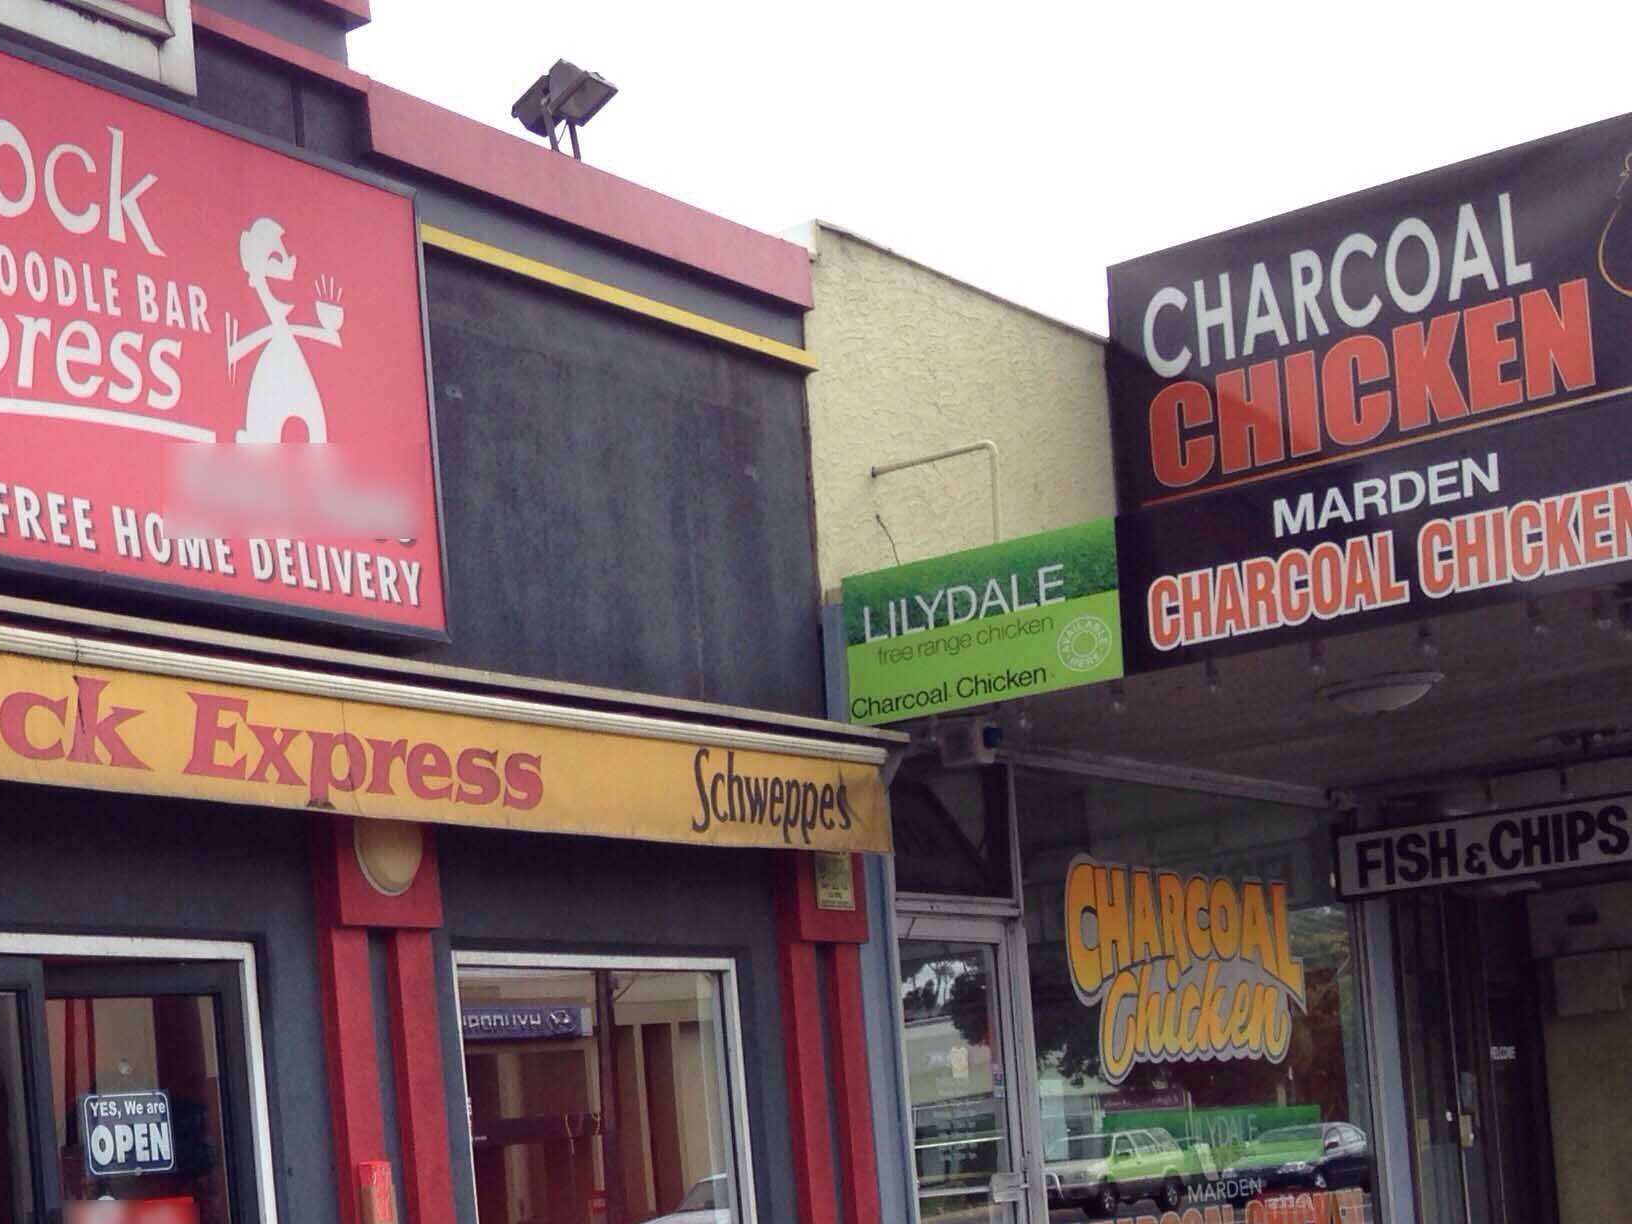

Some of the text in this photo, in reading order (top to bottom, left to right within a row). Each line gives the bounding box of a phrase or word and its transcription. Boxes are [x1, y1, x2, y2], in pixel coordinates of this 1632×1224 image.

[136, 273, 214, 335] BAR
[1142, 192, 1533, 378] CHARCOAL
[1149, 277, 1597, 489] CHICKEN
[1273, 452, 1500, 538] MARDEN
[111, 503, 237, 576] HOME
[248, 537, 422, 608] DELIVERY
[1148, 530, 1411, 652] CHARCOAL
[862, 563, 1067, 644] LILYDALE
[878, 645, 914, 667] free
[917, 630, 973, 660] range
[975, 612, 1056, 646] chicken
[850, 665, 1048, 721] Charcoal Chicken
[182, 691, 545, 811] Express
[691, 746, 852, 845] Schweppes
[1355, 804, 1631, 889] FISH & CHIPS
[1067, 858, 1305, 1005] CHARCOAL
[1101, 955, 1292, 1080] Chicken
[89, 1099, 166, 1119] YES, We are
[90, 1121, 172, 1167] OPEN
[1187, 1177, 1263, 1203] MARDEN
